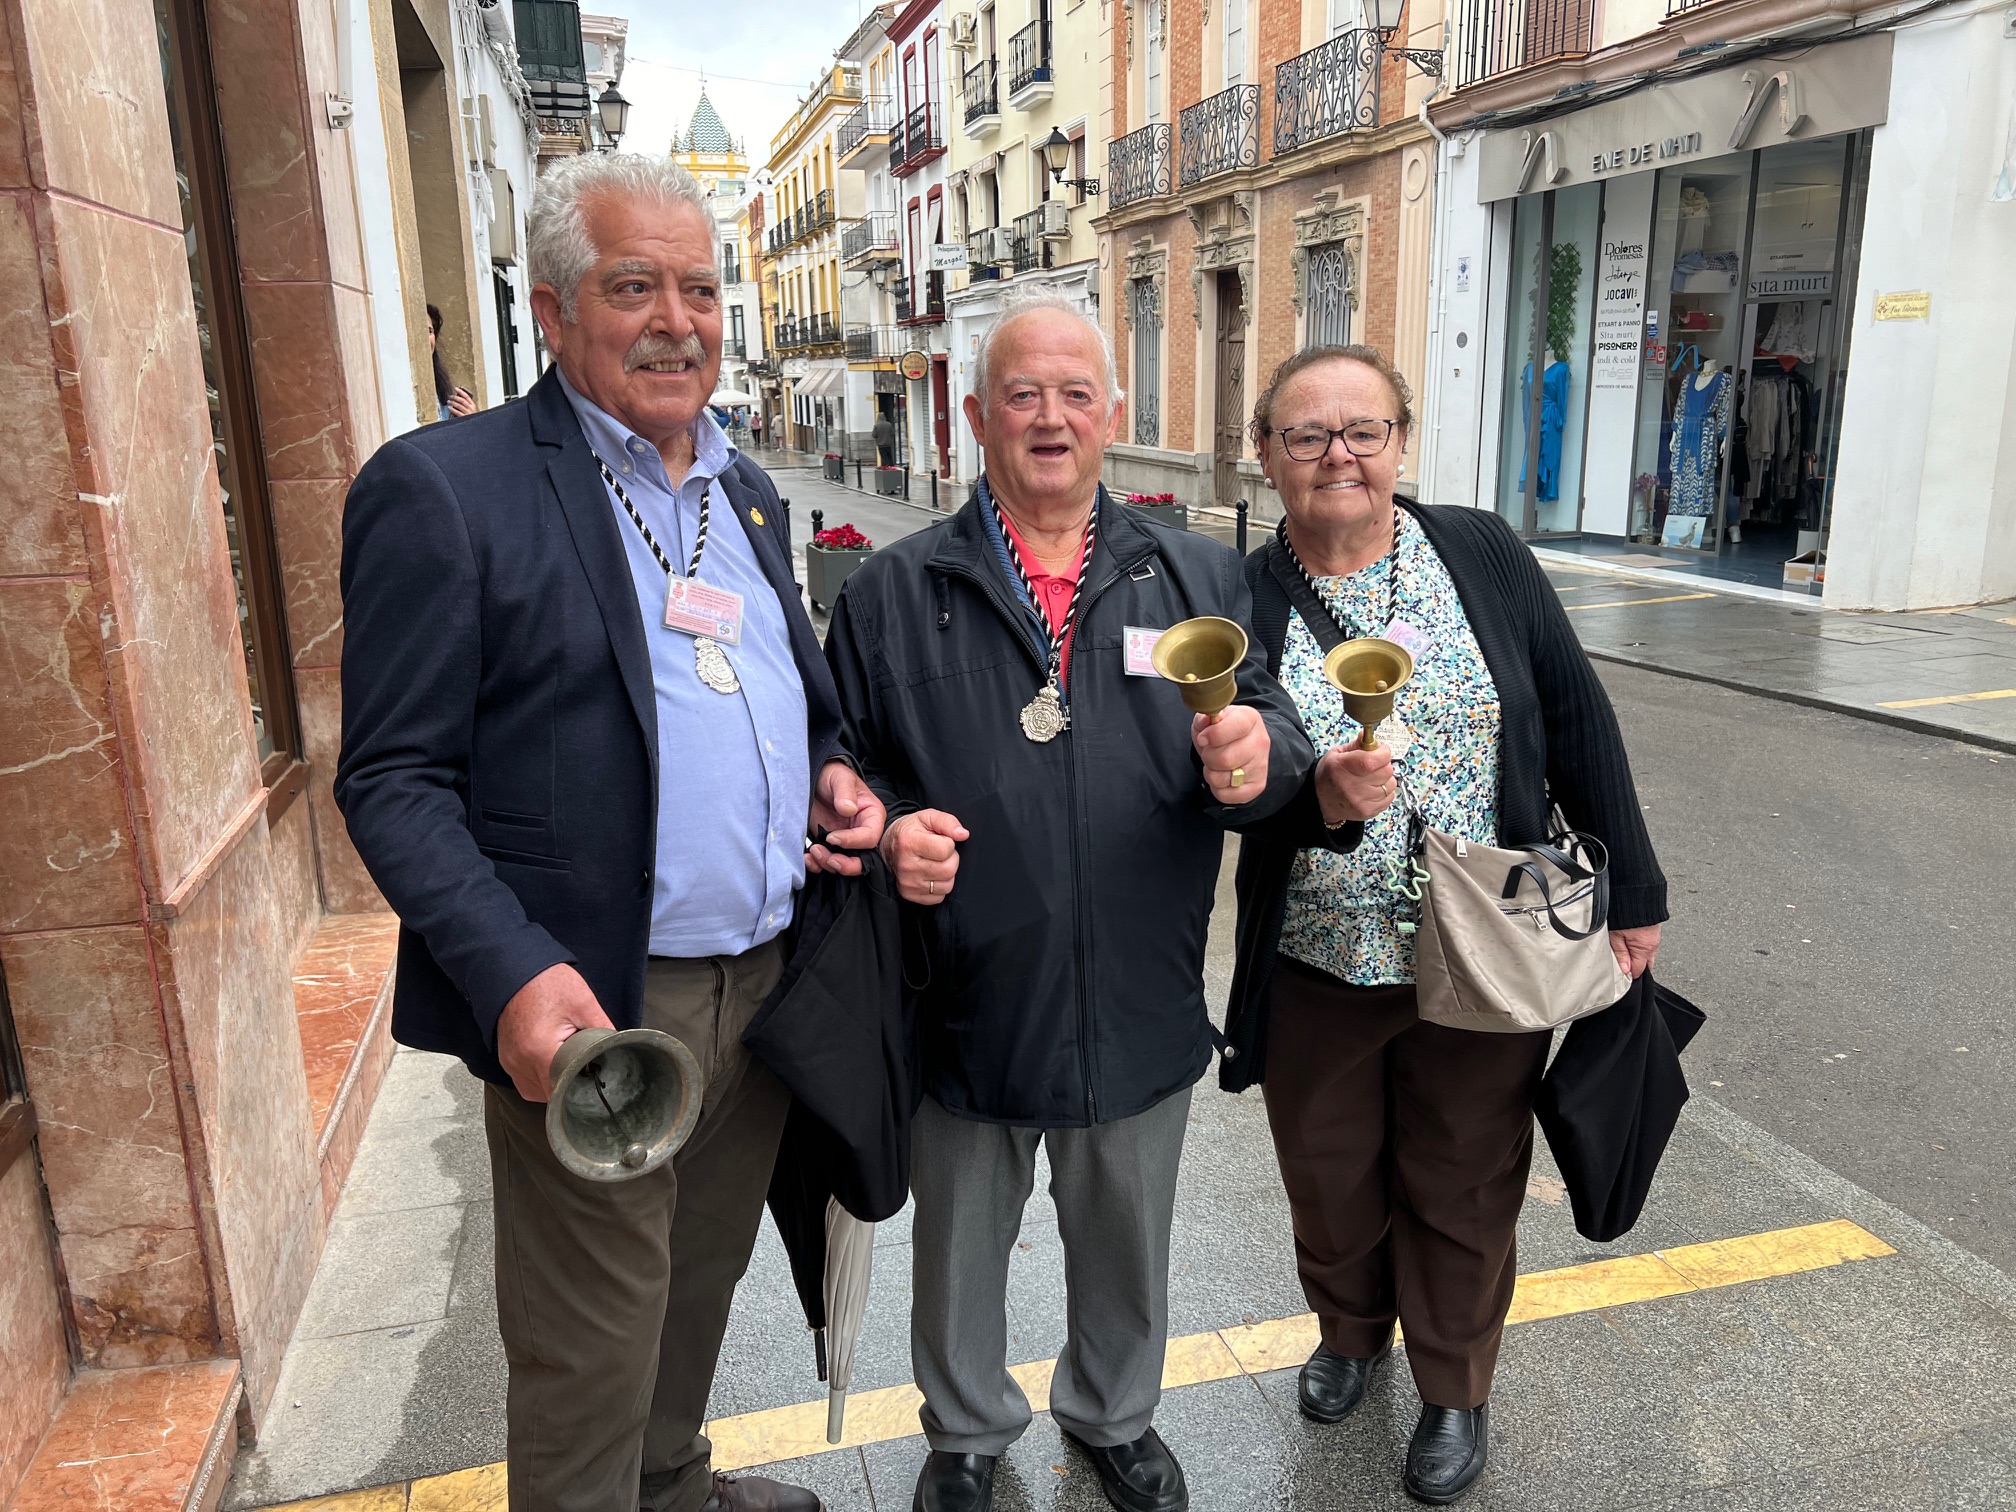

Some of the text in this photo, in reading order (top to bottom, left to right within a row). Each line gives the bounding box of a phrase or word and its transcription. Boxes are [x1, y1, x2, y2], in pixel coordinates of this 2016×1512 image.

[1592, 132, 1701, 173] ENE DE NATI
[1604, 241, 1643, 256] Dolores
[934, 254, 962, 266] Margot
[1783, 276, 1828, 291] murt
[1598, 342, 1638, 350] PISONERO
[1620, 356, 1636, 364] cold
